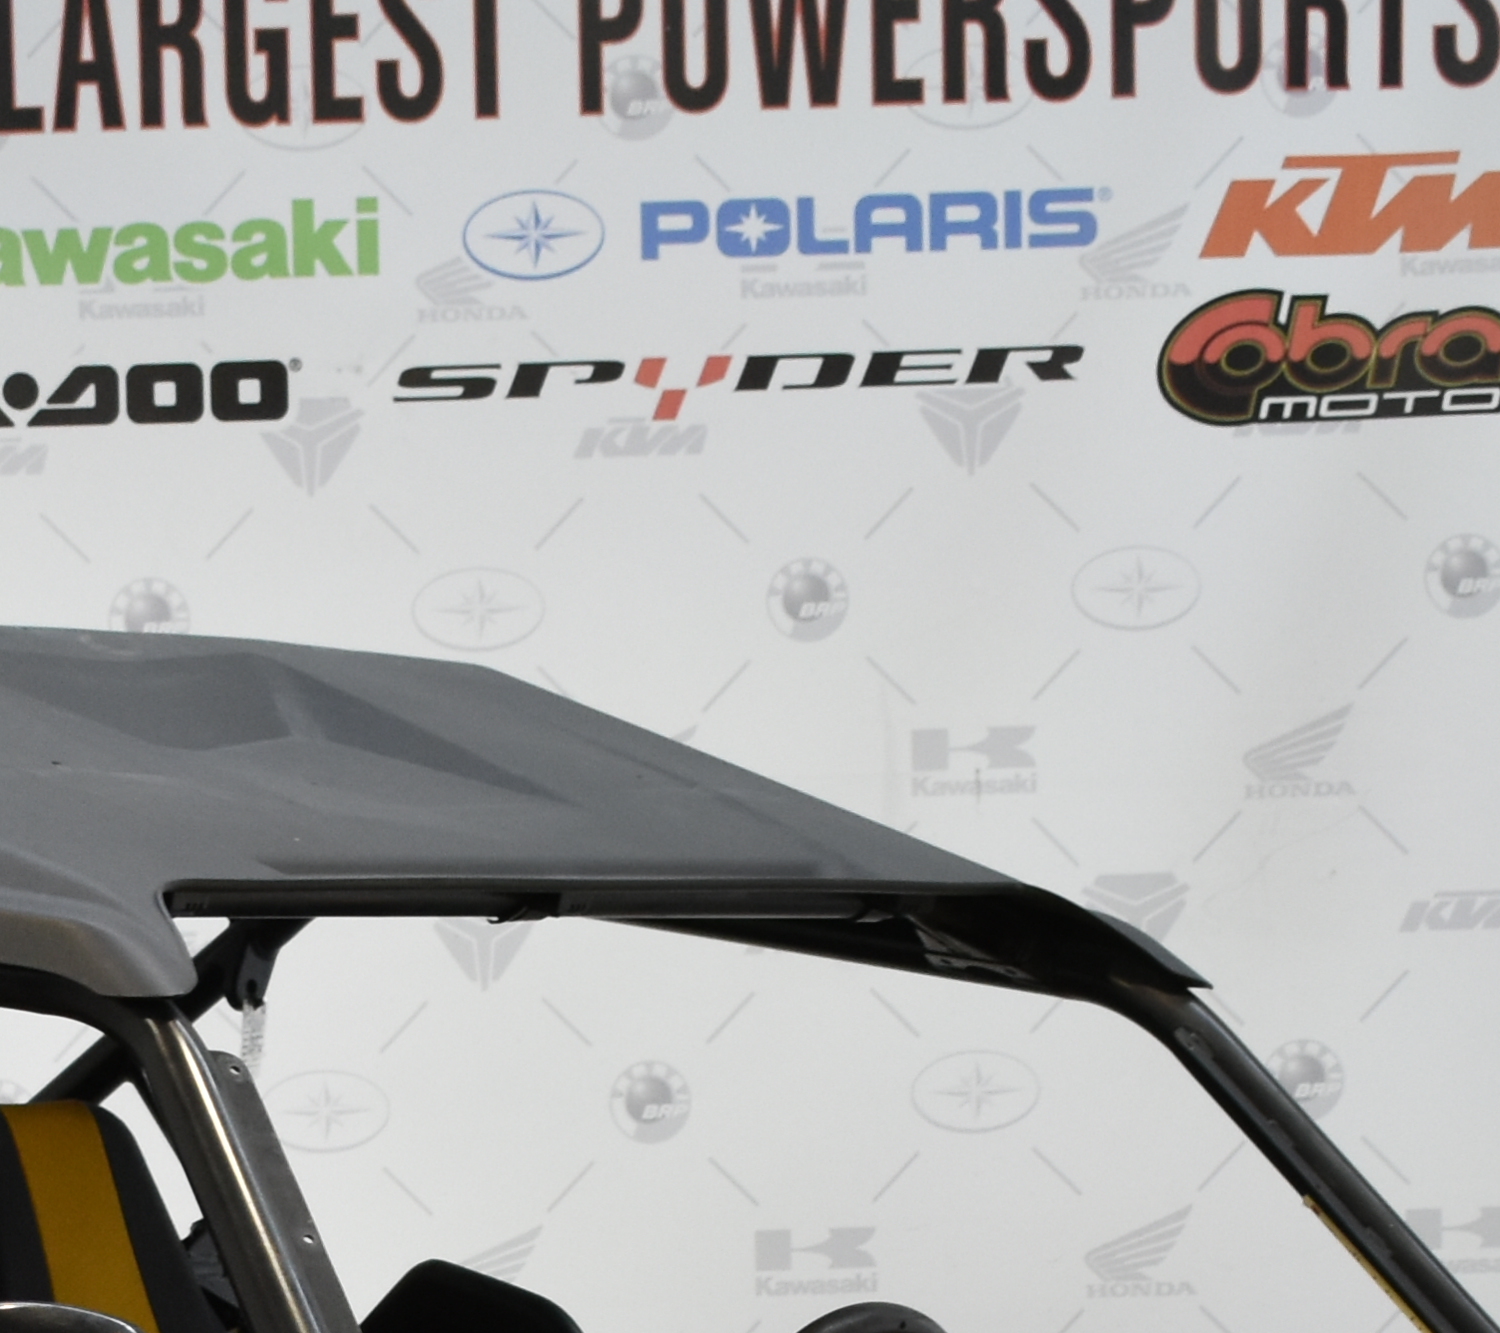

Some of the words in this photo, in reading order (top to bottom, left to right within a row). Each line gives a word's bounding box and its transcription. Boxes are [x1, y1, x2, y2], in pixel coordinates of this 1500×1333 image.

[639, 186, 1099, 262] POLARIS
[740, 274, 868, 299] Kawasaki
[1079, 281, 1192, 301] HONDA
[78, 295, 205, 320] Kawasaki
[417, 303, 528, 323] HONDA
[391, 343, 1087, 421] SPYDER
[1258, 389, 1500, 421] MOTO
[574, 417, 707, 459] KTM
[797, 601, 847, 618] BRP
[911, 771, 1036, 796] Kawasaki
[1244, 781, 1357, 800] HONDA
[1295, 1082, 1342, 1099] BRP
[640, 1103, 690, 1120] BRP
[755, 1273, 878, 1298] Kawasaki
[1086, 1282, 1197, 1299] HONDA
